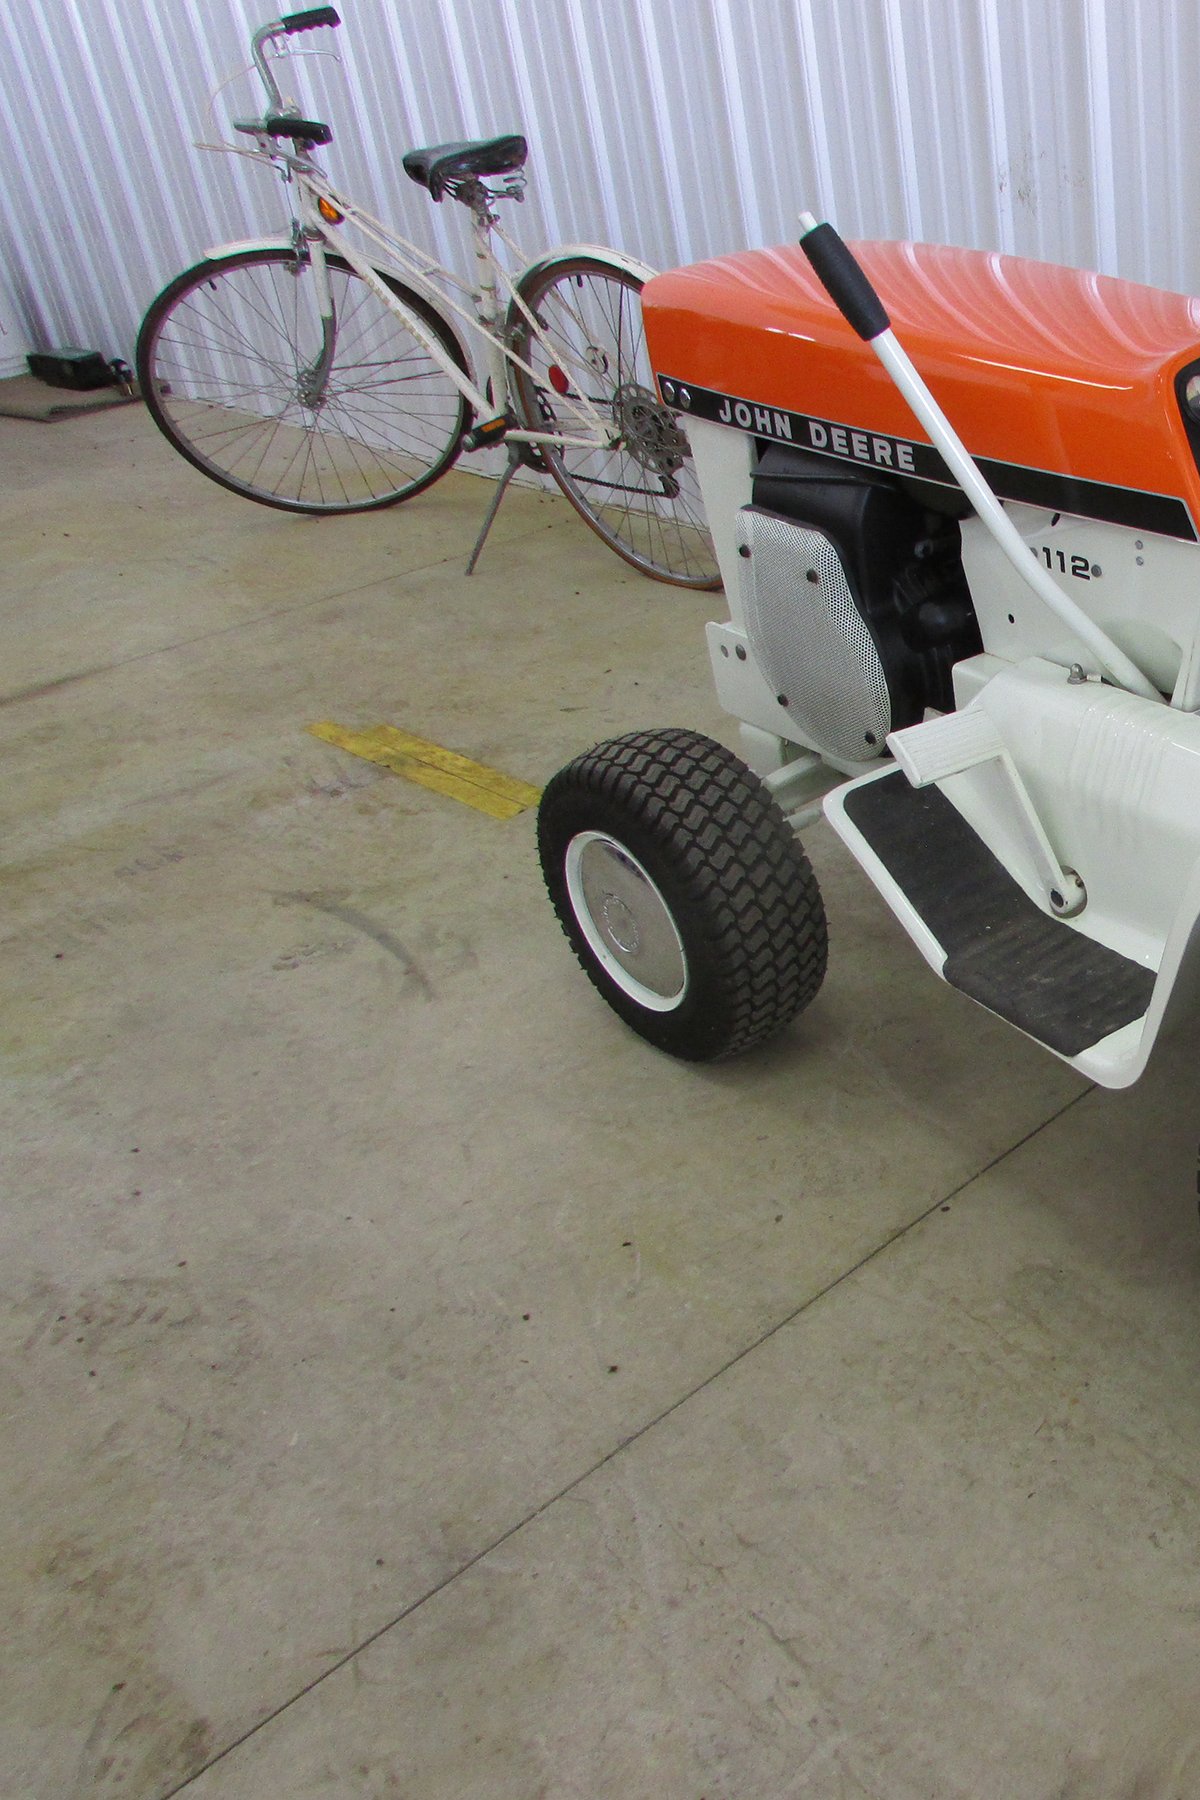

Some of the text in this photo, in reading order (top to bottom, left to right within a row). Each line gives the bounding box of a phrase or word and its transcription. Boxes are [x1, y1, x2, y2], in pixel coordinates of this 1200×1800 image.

[719, 399, 916, 472] JOHN DEERE
[1042, 546, 1091, 581] 112
